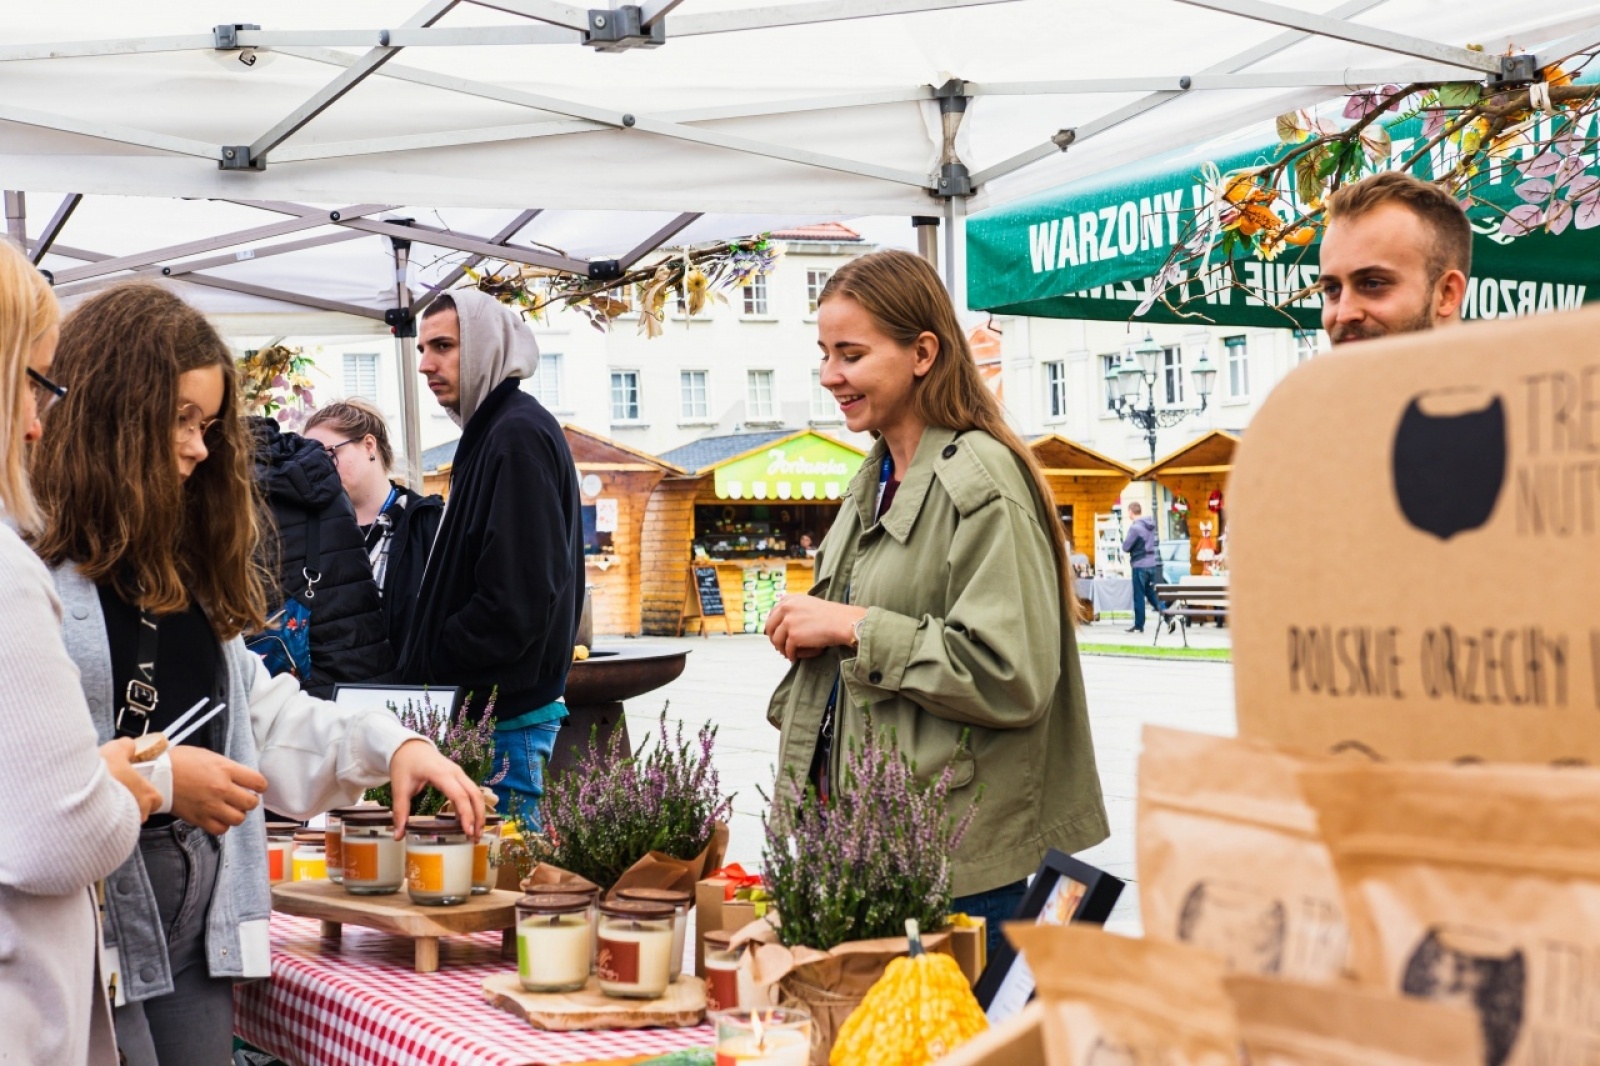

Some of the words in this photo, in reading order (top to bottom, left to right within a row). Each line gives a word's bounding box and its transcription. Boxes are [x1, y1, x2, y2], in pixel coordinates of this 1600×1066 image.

[1029, 187, 1185, 275] WARZONY
[1287, 624, 1405, 700] POLSKIE
[1419, 622, 1570, 708] ORZECHY
